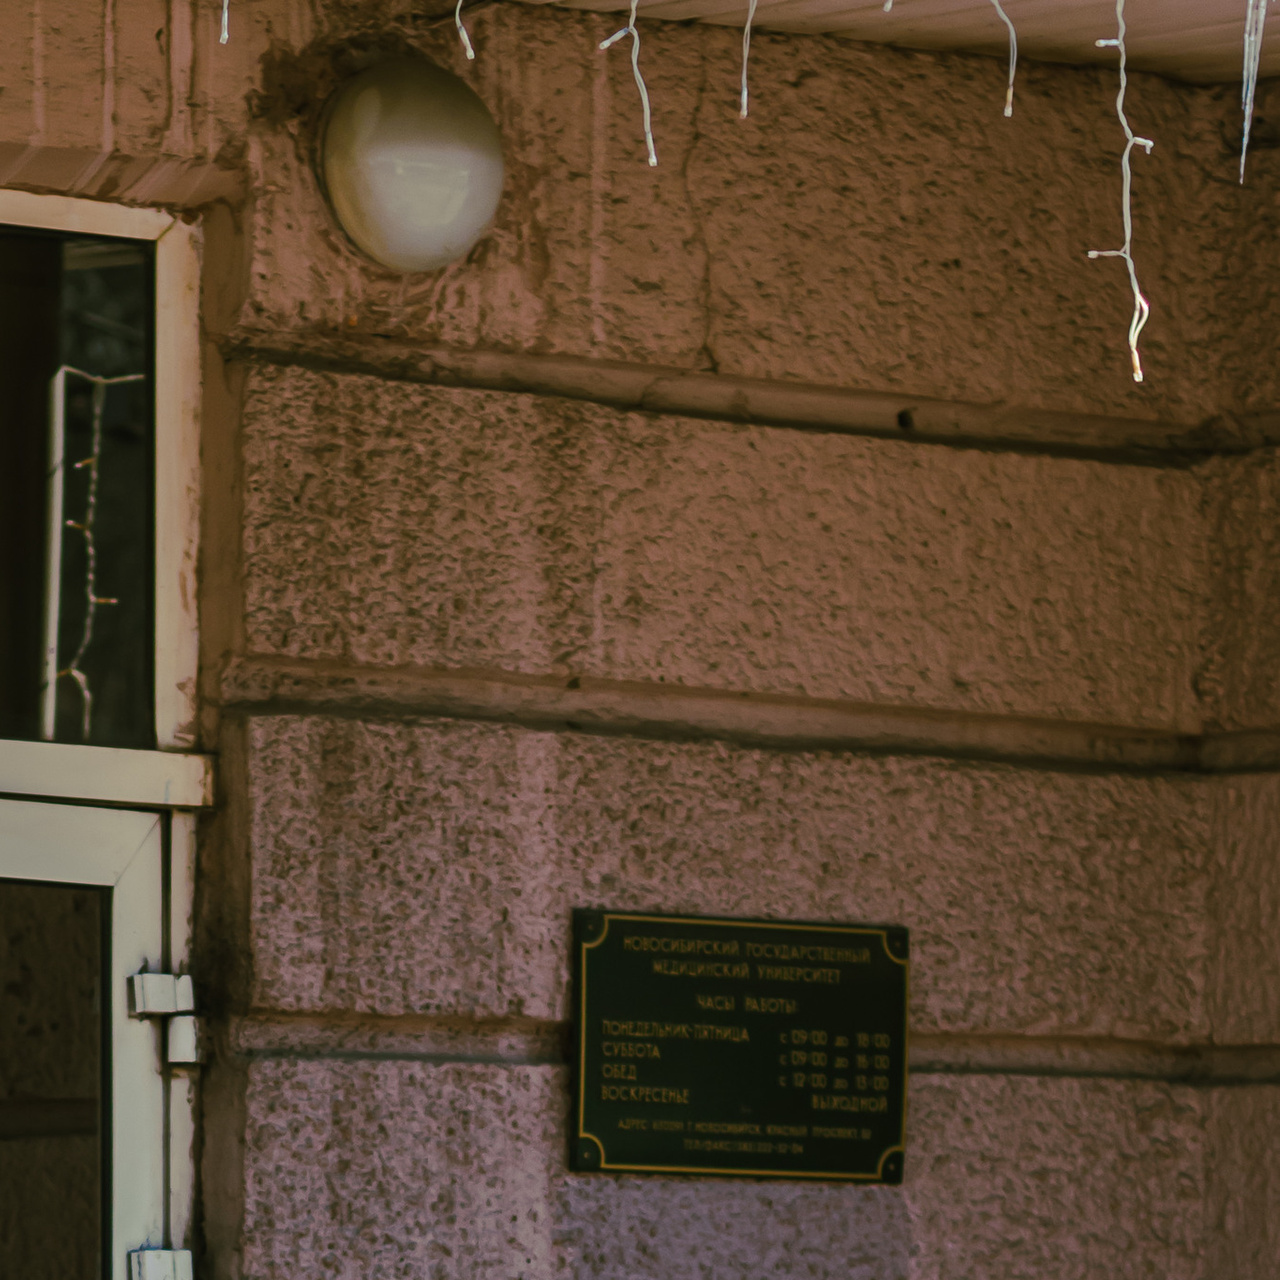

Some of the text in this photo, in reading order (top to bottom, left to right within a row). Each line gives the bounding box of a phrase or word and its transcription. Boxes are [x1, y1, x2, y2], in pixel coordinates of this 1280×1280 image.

[623, 936, 870, 963] НОВОСИБИРСКИЙ ГОСУДАРСТВЕННЫЙ
[653, 959, 841, 984] МЕДИЦИНСКИЙ УНИВЕРСИТЕТ
[696, 994, 734, 1011] ЧАСЫ
[602, 1042, 660, 1059] СУББОТА
[602, 1064, 637, 1080] ОБЕД
[601, 1084, 888, 1112] ВОСКРЕСЕНЬЕ ВЫХОДНОЙ
